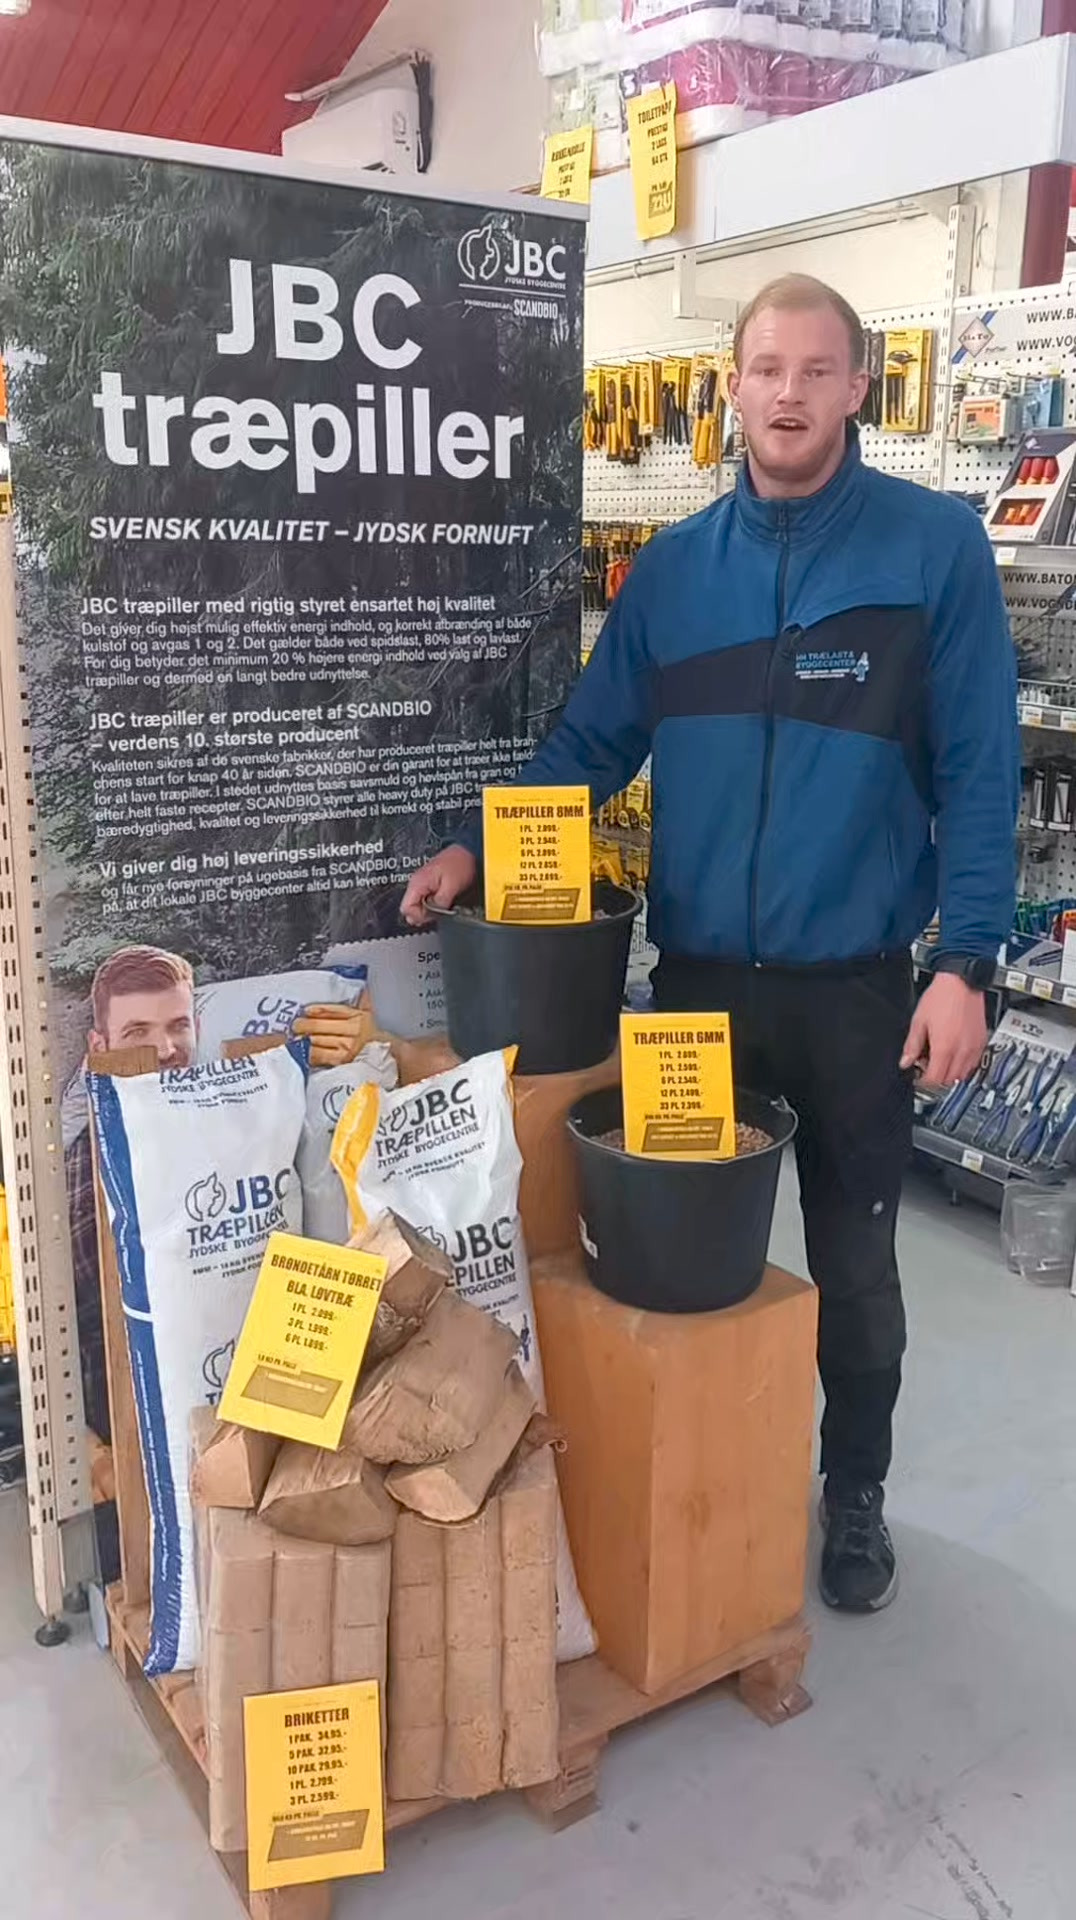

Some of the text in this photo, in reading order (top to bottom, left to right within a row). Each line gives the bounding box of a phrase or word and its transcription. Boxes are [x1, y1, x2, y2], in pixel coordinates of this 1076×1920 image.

[505, 240, 566, 280] JBC
[217, 258, 423, 370] JBC
[514, 299, 558, 319] SCANDBIO
[92, 371, 524, 493] træpiller
[89, 516, 201, 541] SVENSK
[209, 519, 330, 542] KVALITET
[353, 522, 427, 544] JYDSK
[431, 523, 534, 546] FORNUFT
[80, 595, 496, 618] JBC træpiller med rigtig styret ensartet høj kvalitet
[243, 617, 493, 635] effektiv energi indhold, korrekt afbrænding
[82, 634, 421, 652] kulstof gælder spidslast,
[135, 649, 425, 670] betyder minimum højere energi indhold
[85, 667, 371, 688] træpiller dermed udnyttelse.
[89, 699, 433, 731] JBC træpiller er produceret af SCANDBIO
[109, 725, 359, 752] verdens 10. største producent
[92, 740, 477, 773] Kvaliteten sikres svenske fabrikker, produceret træpiller
[257, 755, 434, 779] siden. SCANDBIO garant
[160, 787, 212, 803] træpiller.
[224, 783, 261, 797] stedet
[264, 781, 314, 796] udnyttes
[350, 774, 400, 789] savsmuld
[97, 818, 196, 837] bæredygtighed,
[200, 814, 241, 829] kvalitet
[263, 805, 367, 824] leveringssikkerhed
[381, 800, 416, 815] korrekt
[435, 795, 462, 809] stabil
[189, 794, 355, 815] recepter. SCANDBIO styrer
[494, 806, 584, 819] TRÆPILLER 8MM
[100, 838, 384, 879] Vi giver dig høj leveringssikkerhed
[161, 873, 388, 906] lokale byggecenter altid levere
[168, 866, 309, 891] forsyninger ugebasis
[633, 1031, 724, 1045] TRÆPILLER 6MM
[410, 1078, 472, 1126] JBC
[375, 1104, 476, 1157] TRÆPILLEN
[378, 1122, 480, 1168] JYDSKE BYGGECENTRE
[229, 1168, 291, 1213] JBC
[186, 1202, 285, 1245] TRÆPILLEN
[190, 1242, 227, 1258] JYDSKE
[452, 1216, 513, 1263] JBC
[271, 1254, 340, 1282] BRØNDETÅRN
[342, 1270, 383, 1292] TØRRET
[293, 1303, 296, 1311] 1
[310, 1285, 355, 1308] LØVTRÆ
[288, 1317, 294, 1326] 3
[285, 1333, 291, 1342] 6
[284, 1708, 349, 1728] BRIKETTER
[289, 1735, 292, 1744] 1
[289, 1750, 294, 1759] 5
[288, 1765, 297, 1775] 10
[290, 1781, 293, 1790] 1
[290, 1796, 295, 1805] 3
